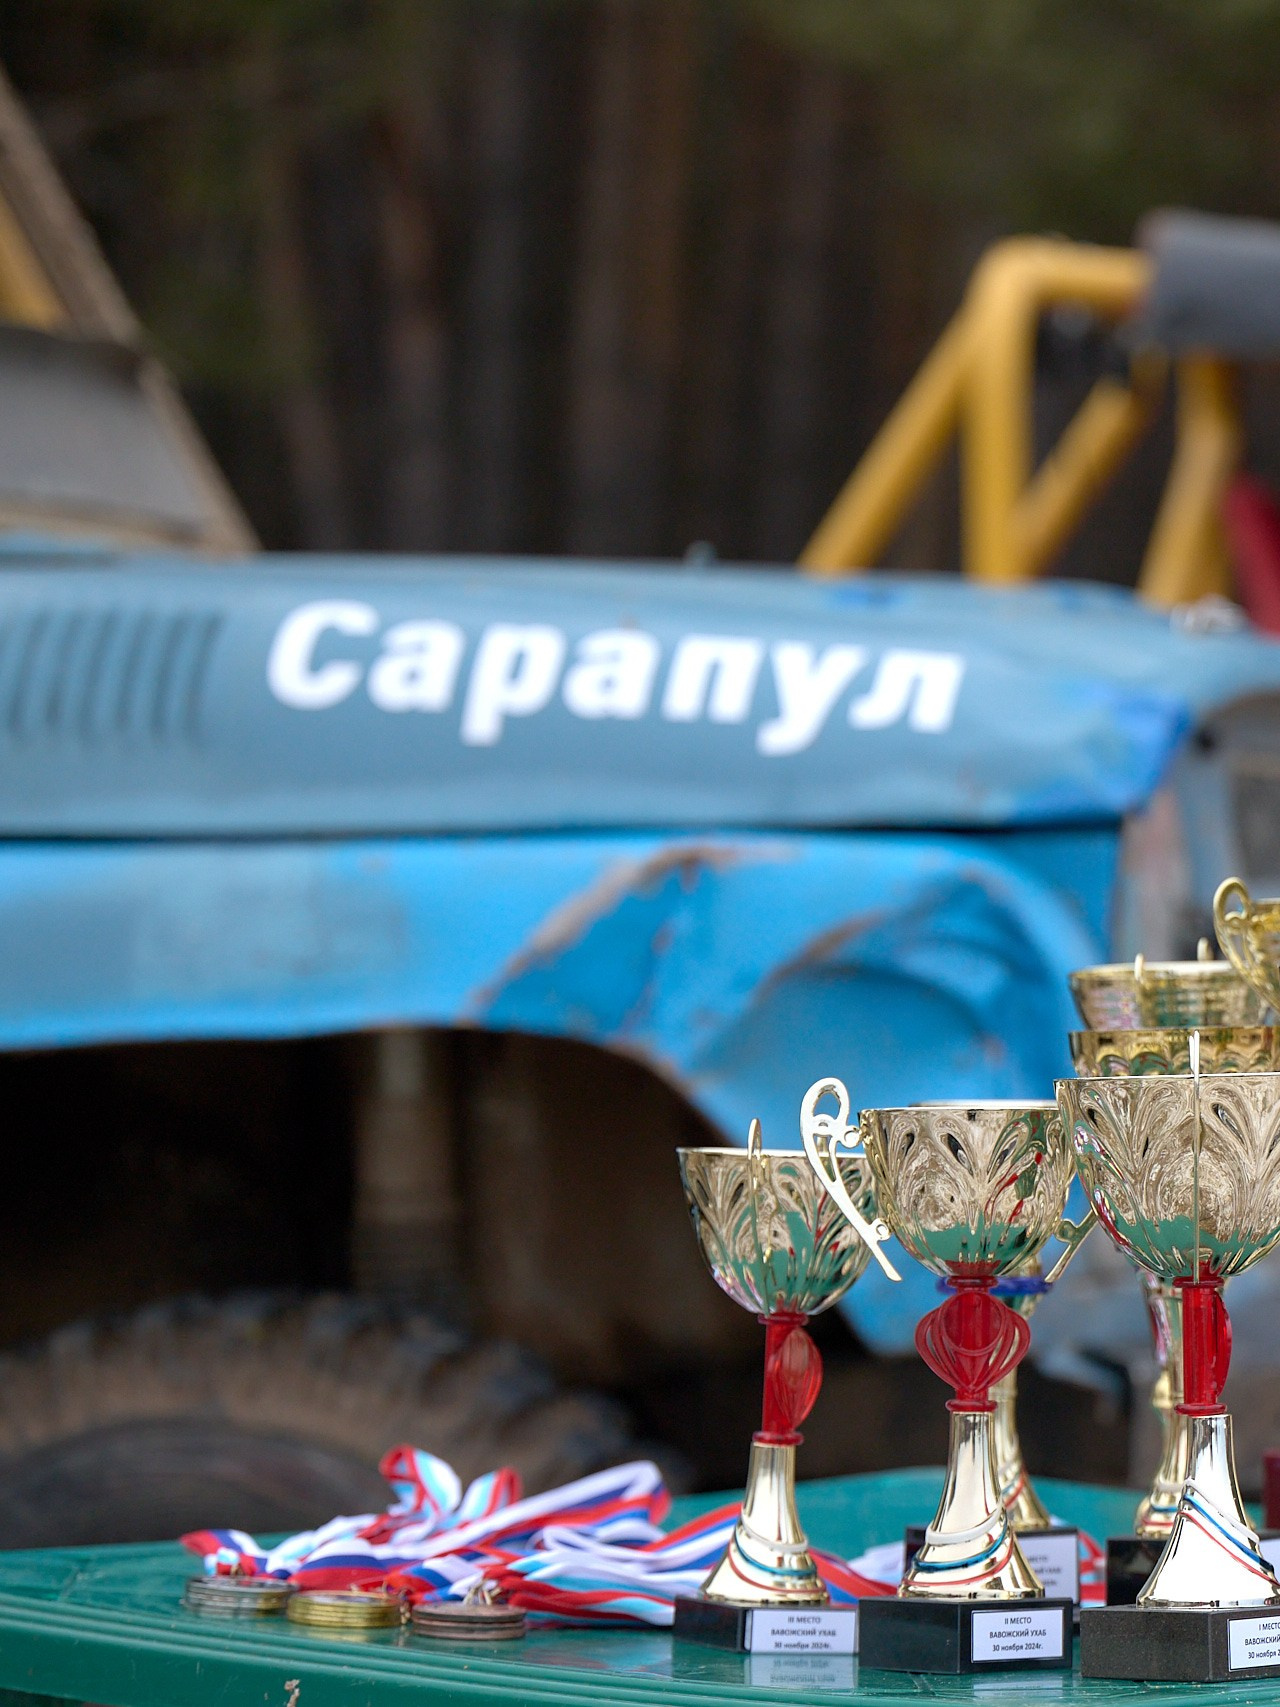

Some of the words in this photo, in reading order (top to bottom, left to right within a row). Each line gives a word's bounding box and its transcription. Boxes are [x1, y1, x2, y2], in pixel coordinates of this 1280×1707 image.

[266, 597, 968, 757] Сарапул
[771, 1628, 816, 1636] ВАВОЖСКИЙ
[990, 1629, 1029, 1638] ВАВОЖСКИЙ
[1030, 1629, 1046, 1637] УХАБ
[1245, 1634, 1280, 1645] ВАВОЖСКИЙ
[784, 1641, 809, 1649] ноября
[993, 1644, 1000, 1652] 30
[1001, 1643, 1023, 1652] ноября
[1025, 1642, 1044, 1650] 2024г.
[1248, 1651, 1255, 1659] 30
[1256, 1650, 1276, 1658] ноября
